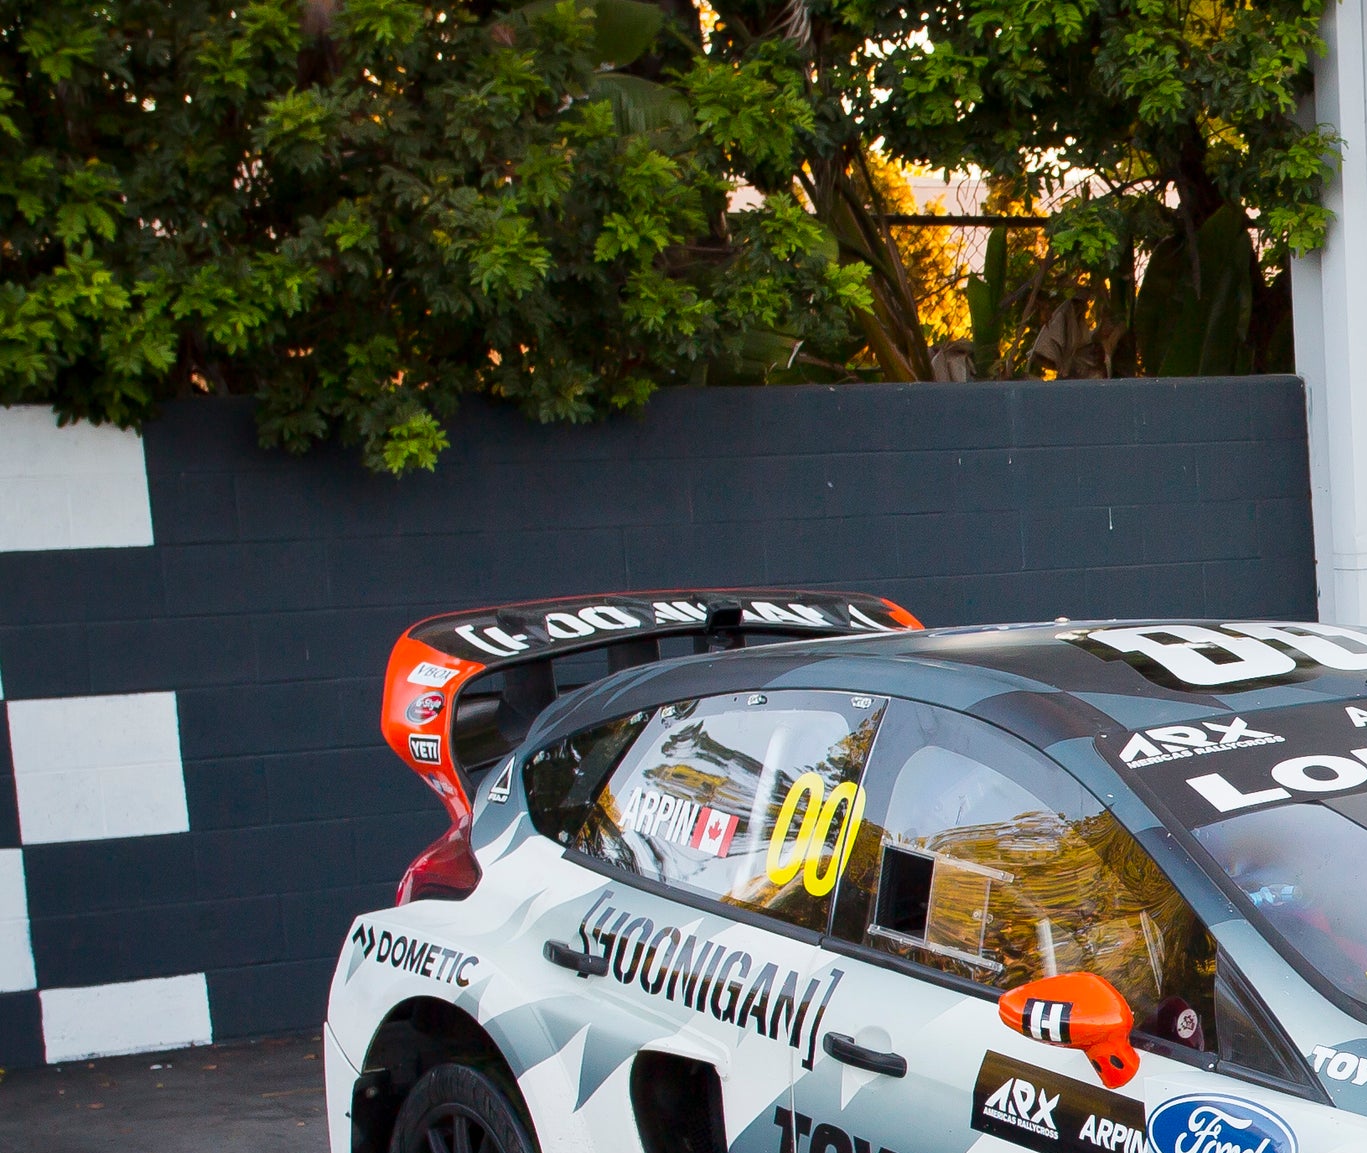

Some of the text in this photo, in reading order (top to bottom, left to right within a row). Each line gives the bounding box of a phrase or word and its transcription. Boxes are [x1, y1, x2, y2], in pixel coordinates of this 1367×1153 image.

[417, 664, 453, 680] VBOX
[411, 740, 438, 759] YETI
[1193, 735, 1286, 755] RALLYCROSS
[618, 786, 700, 847] ARPIN
[376, 931, 480, 987] DOMETIC
[1030, 1001, 1064, 1041] H
[985, 1078, 1060, 1129] ARX
[983, 1106, 1059, 1140] AMERICAS RALLYCROSS
